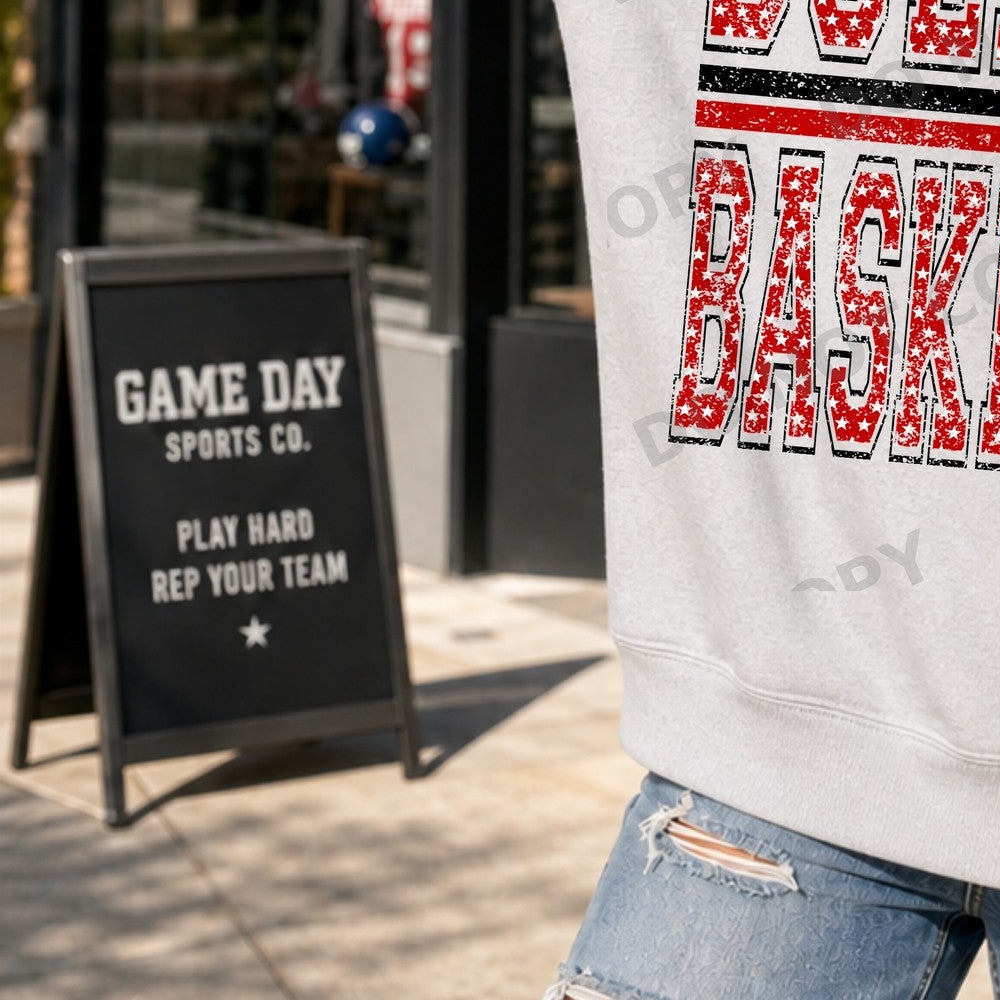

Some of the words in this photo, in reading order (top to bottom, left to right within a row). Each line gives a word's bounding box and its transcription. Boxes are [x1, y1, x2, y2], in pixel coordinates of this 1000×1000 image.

[114, 362, 250, 425] GAME
[258, 355, 345, 413] DAY
[165, 425, 262, 463] SPORTS
[270, 421, 312, 455] CO.
[176, 515, 239, 553] PLAY
[247, 507, 315, 546] HARD
[151, 566, 201, 603] REP
[206, 558, 275, 597] YOUR
[280, 550, 349, 588] TEAM
